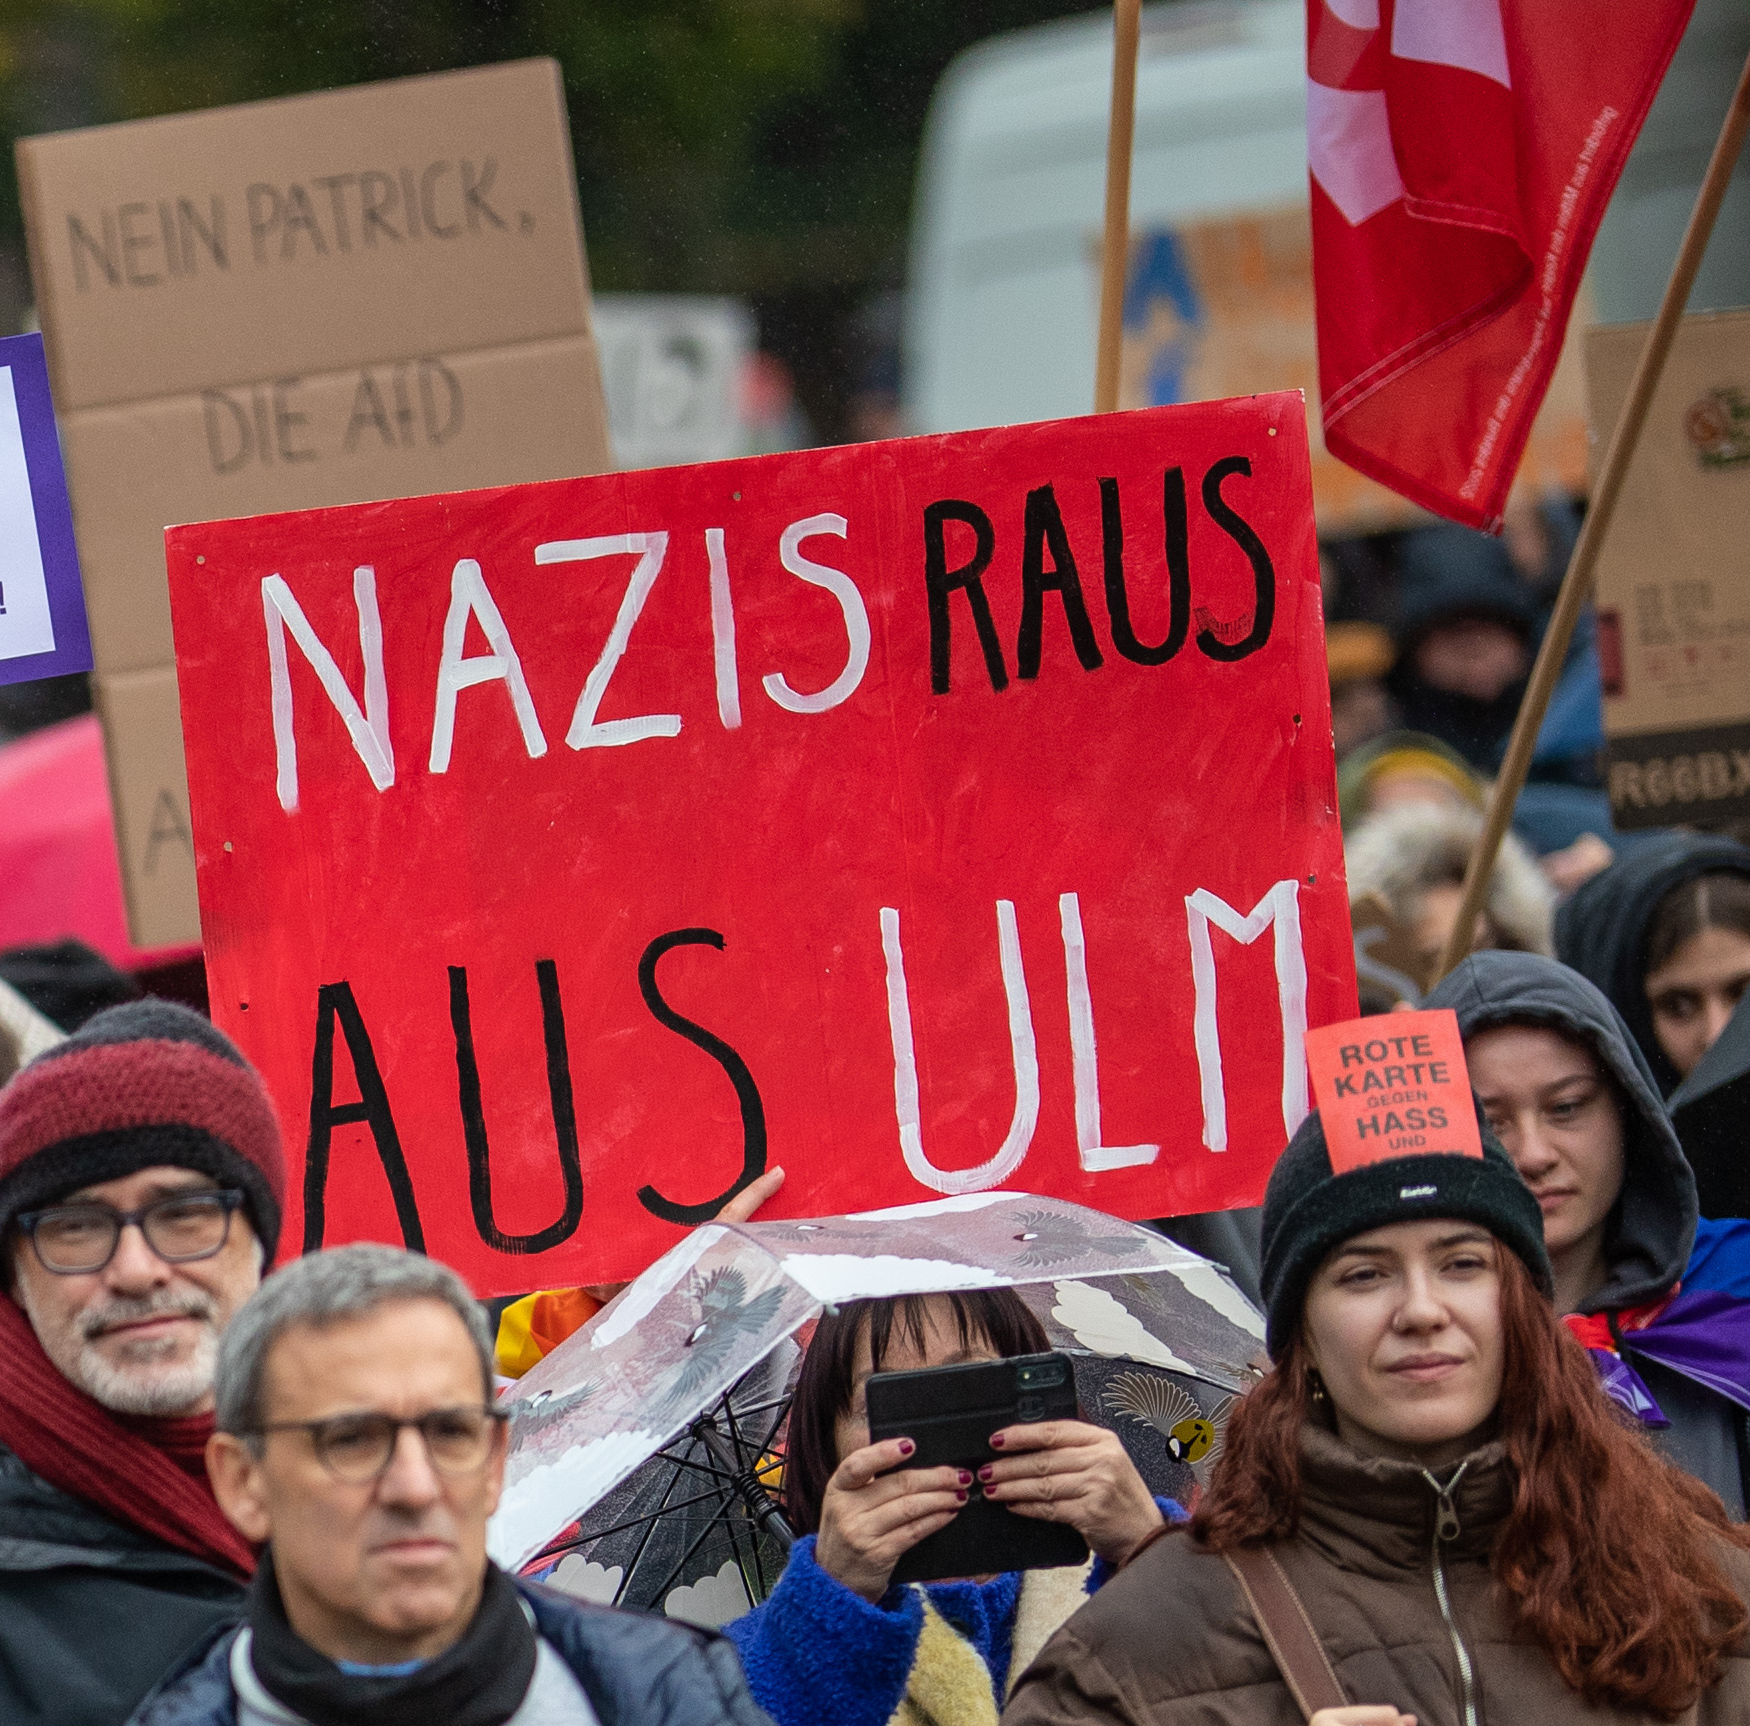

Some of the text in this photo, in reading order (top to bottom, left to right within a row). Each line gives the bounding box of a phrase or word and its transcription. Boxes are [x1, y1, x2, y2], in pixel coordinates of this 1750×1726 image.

[66, 194, 230, 293] NEIN
[201, 374, 318, 475] DIE
[260, 456, 1277, 813] NAZIS RAUS
[302, 878, 1311, 1256] AUS ULM
[1339, 1034, 1433, 1069] ROTE
[1333, 1062, 1451, 1099] KARTE
[1366, 1091, 1429, 1109] GEGEN
[1356, 1106, 1449, 1140] HASS
[1388, 1135, 1427, 1151] UND
